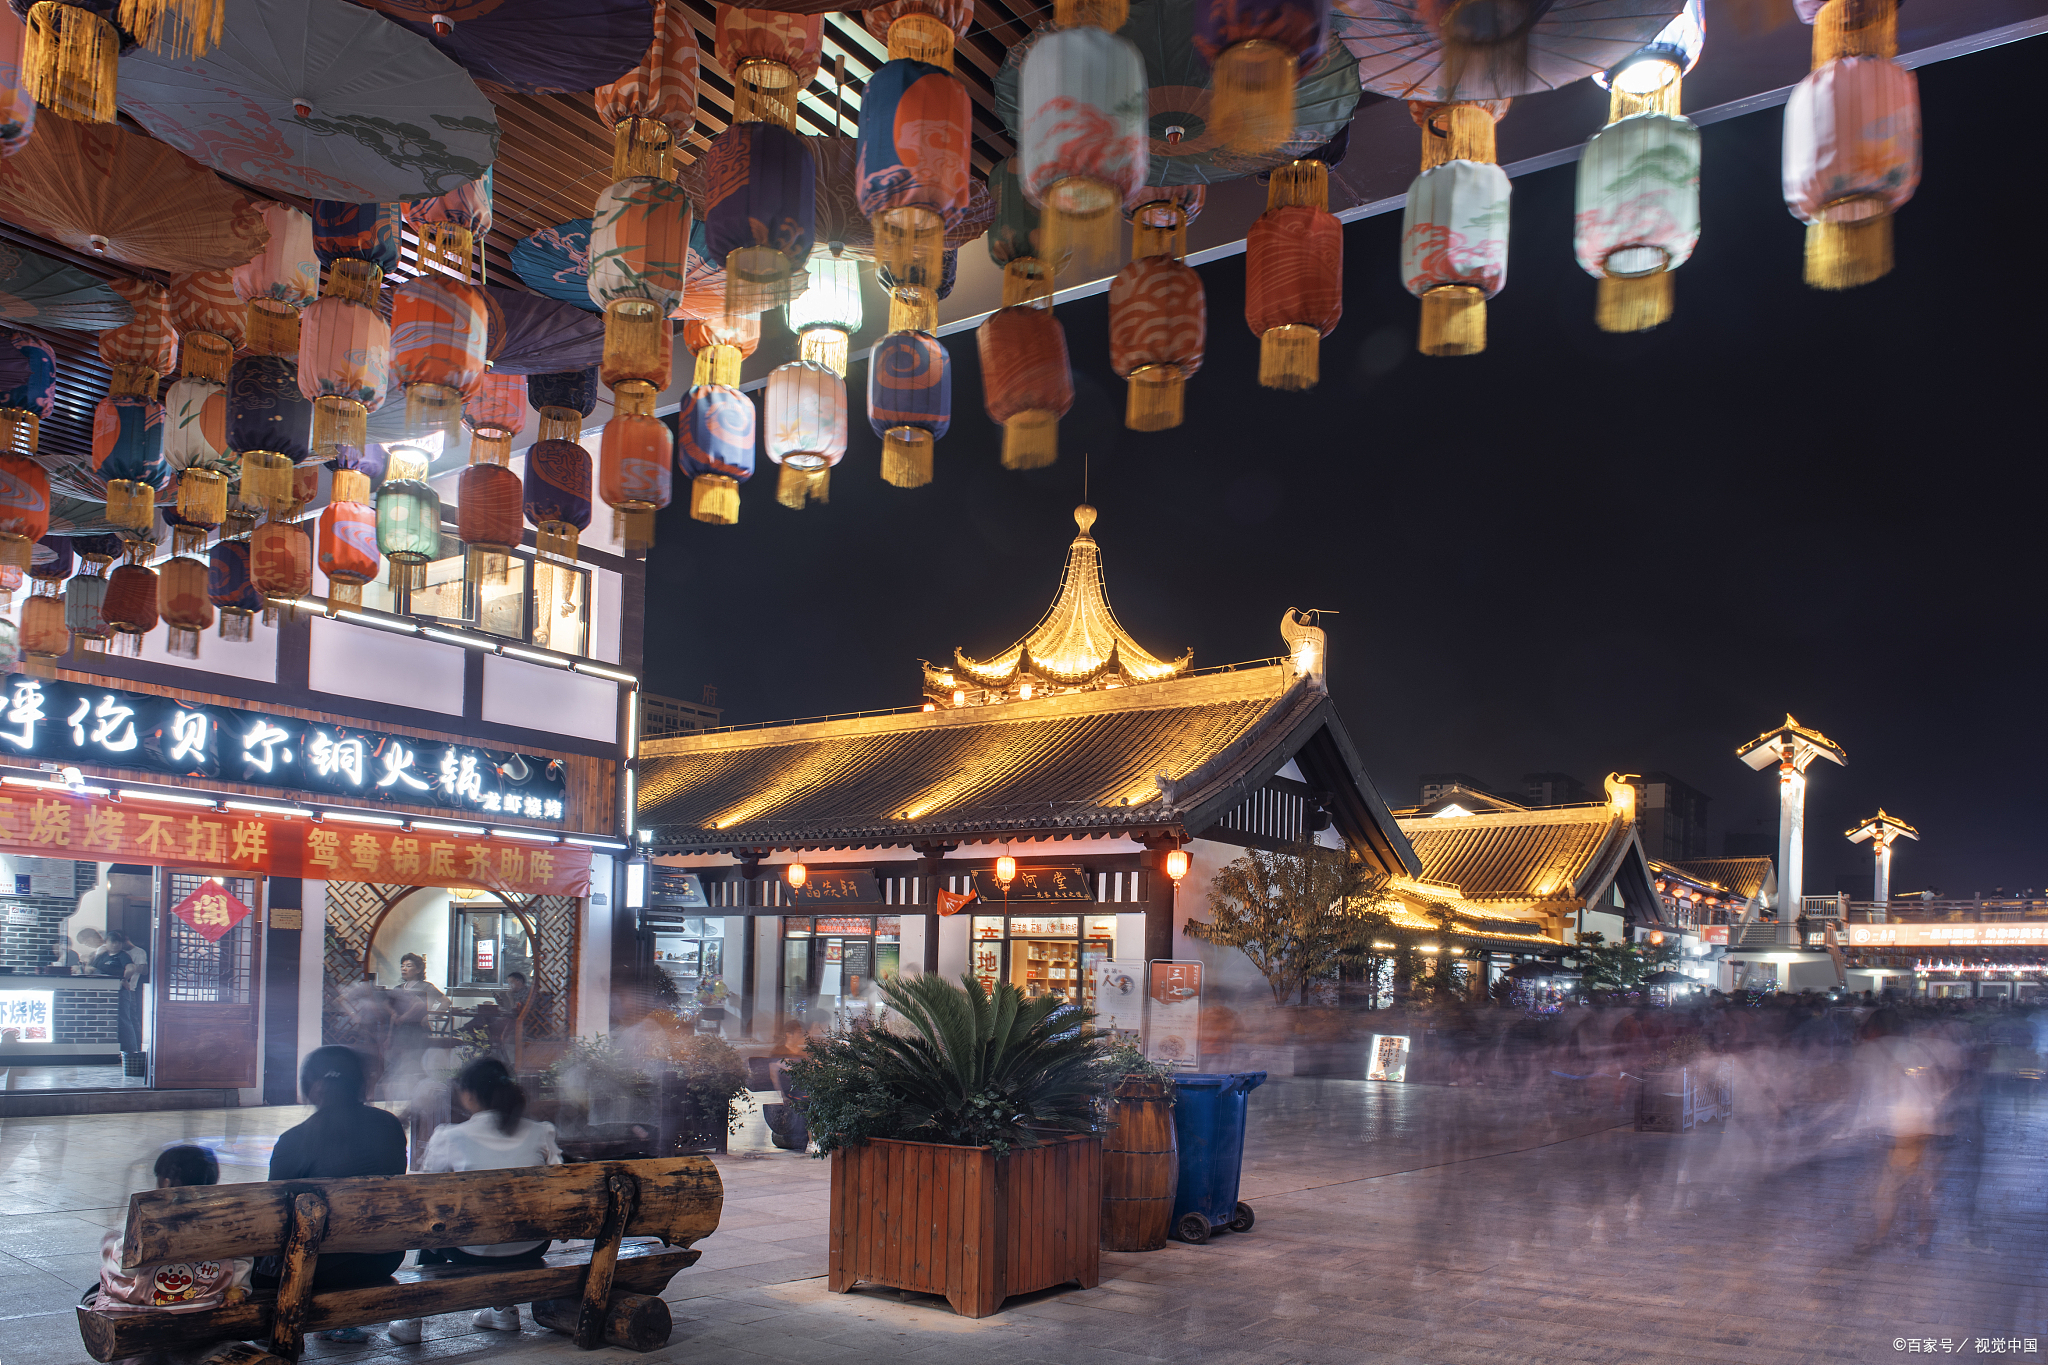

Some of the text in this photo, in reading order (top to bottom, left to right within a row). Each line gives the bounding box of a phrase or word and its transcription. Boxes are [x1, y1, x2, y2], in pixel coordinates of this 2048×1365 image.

[0, 680, 482, 800] 呼伦贝尔铜火锅
[482, 791, 563, 820] 龙虾烧烤
[307, 827, 555, 886] 鸳鸯锅底齐助阵
[1045, 923, 1056, 934] 人参
[1168, 968, 1184, 996] 三七
